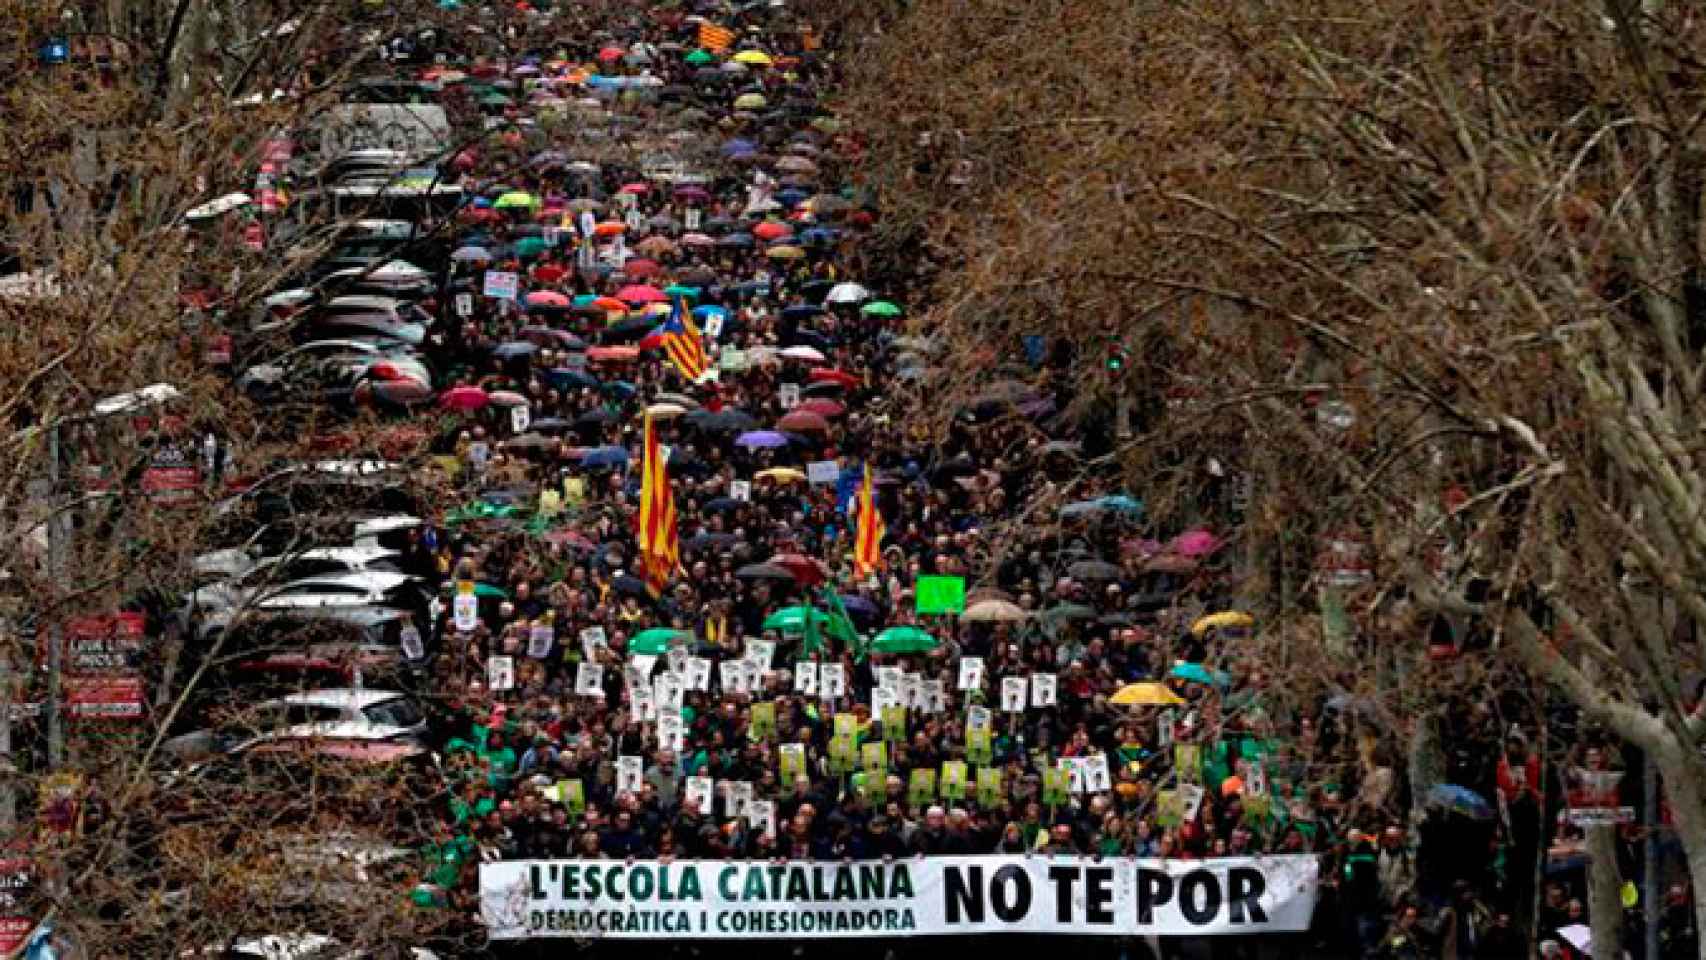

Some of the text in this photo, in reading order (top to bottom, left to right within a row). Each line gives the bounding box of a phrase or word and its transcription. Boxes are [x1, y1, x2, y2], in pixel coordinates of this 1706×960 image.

[530, 863, 916, 901] L'ESCOLA CATALANA
[943, 864, 1269, 925] NO TE POR
[531, 905, 916, 933] DEMOCRÀTICA I COHESIONADORA
